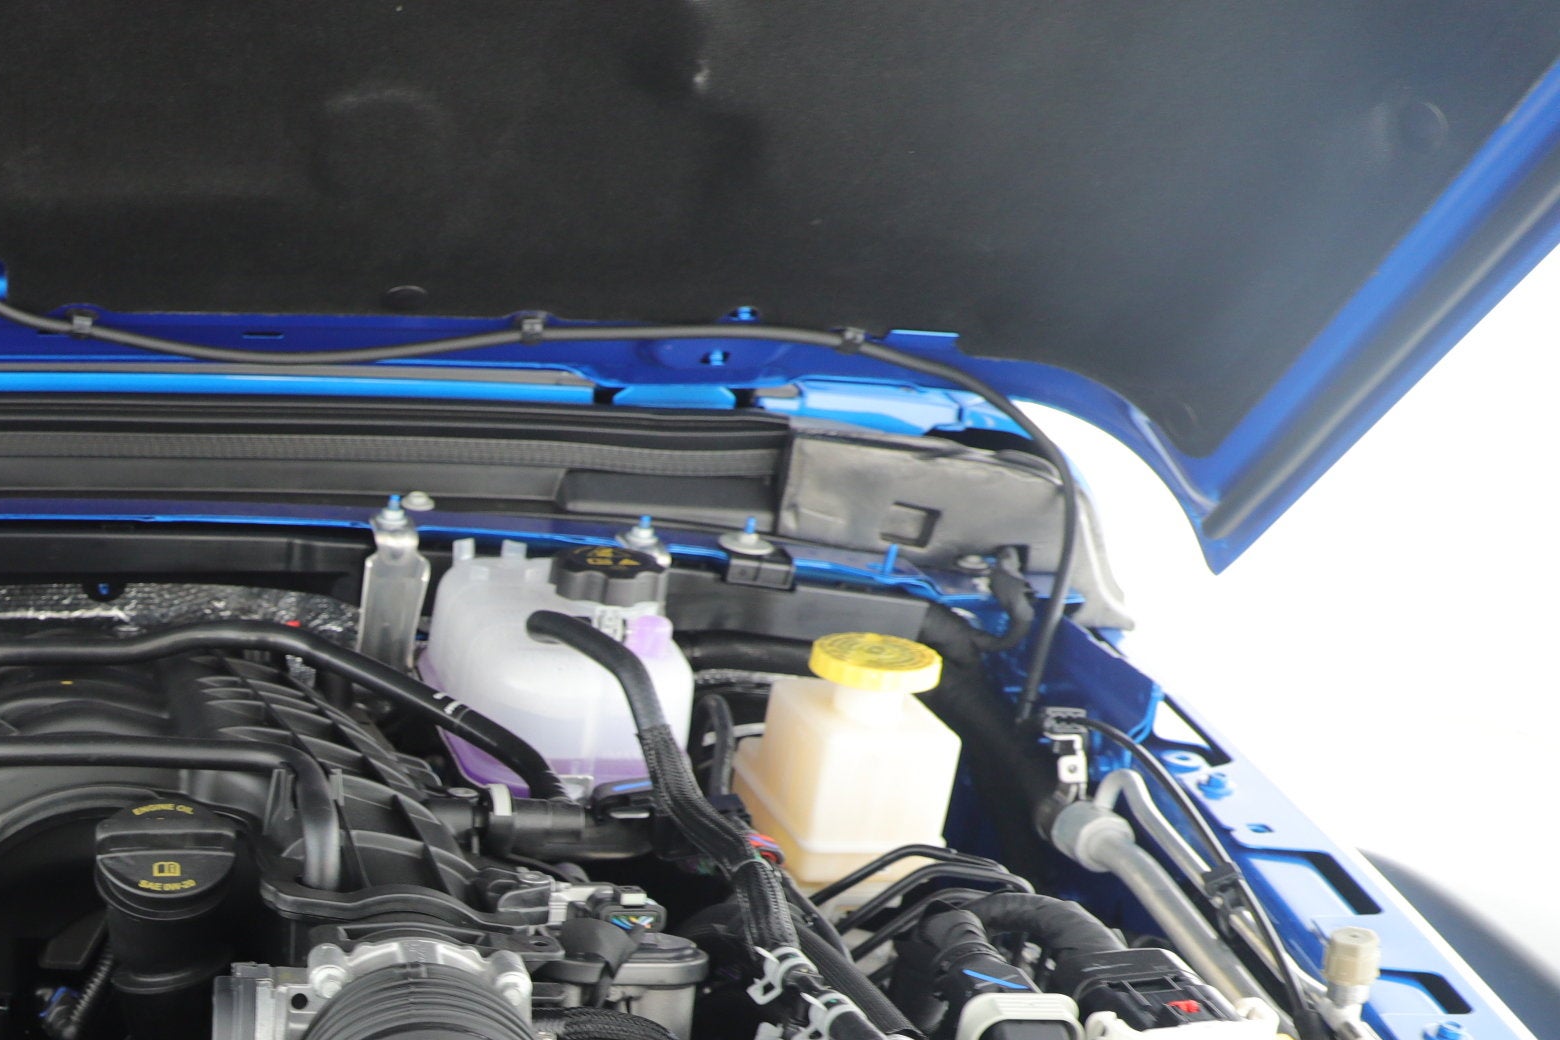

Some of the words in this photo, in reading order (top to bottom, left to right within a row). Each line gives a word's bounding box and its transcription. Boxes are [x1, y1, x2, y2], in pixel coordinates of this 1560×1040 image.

[132, 803, 175, 815] ENGINE
[175, 804, 194, 815] OIL
[138, 880, 162, 891] SAE
